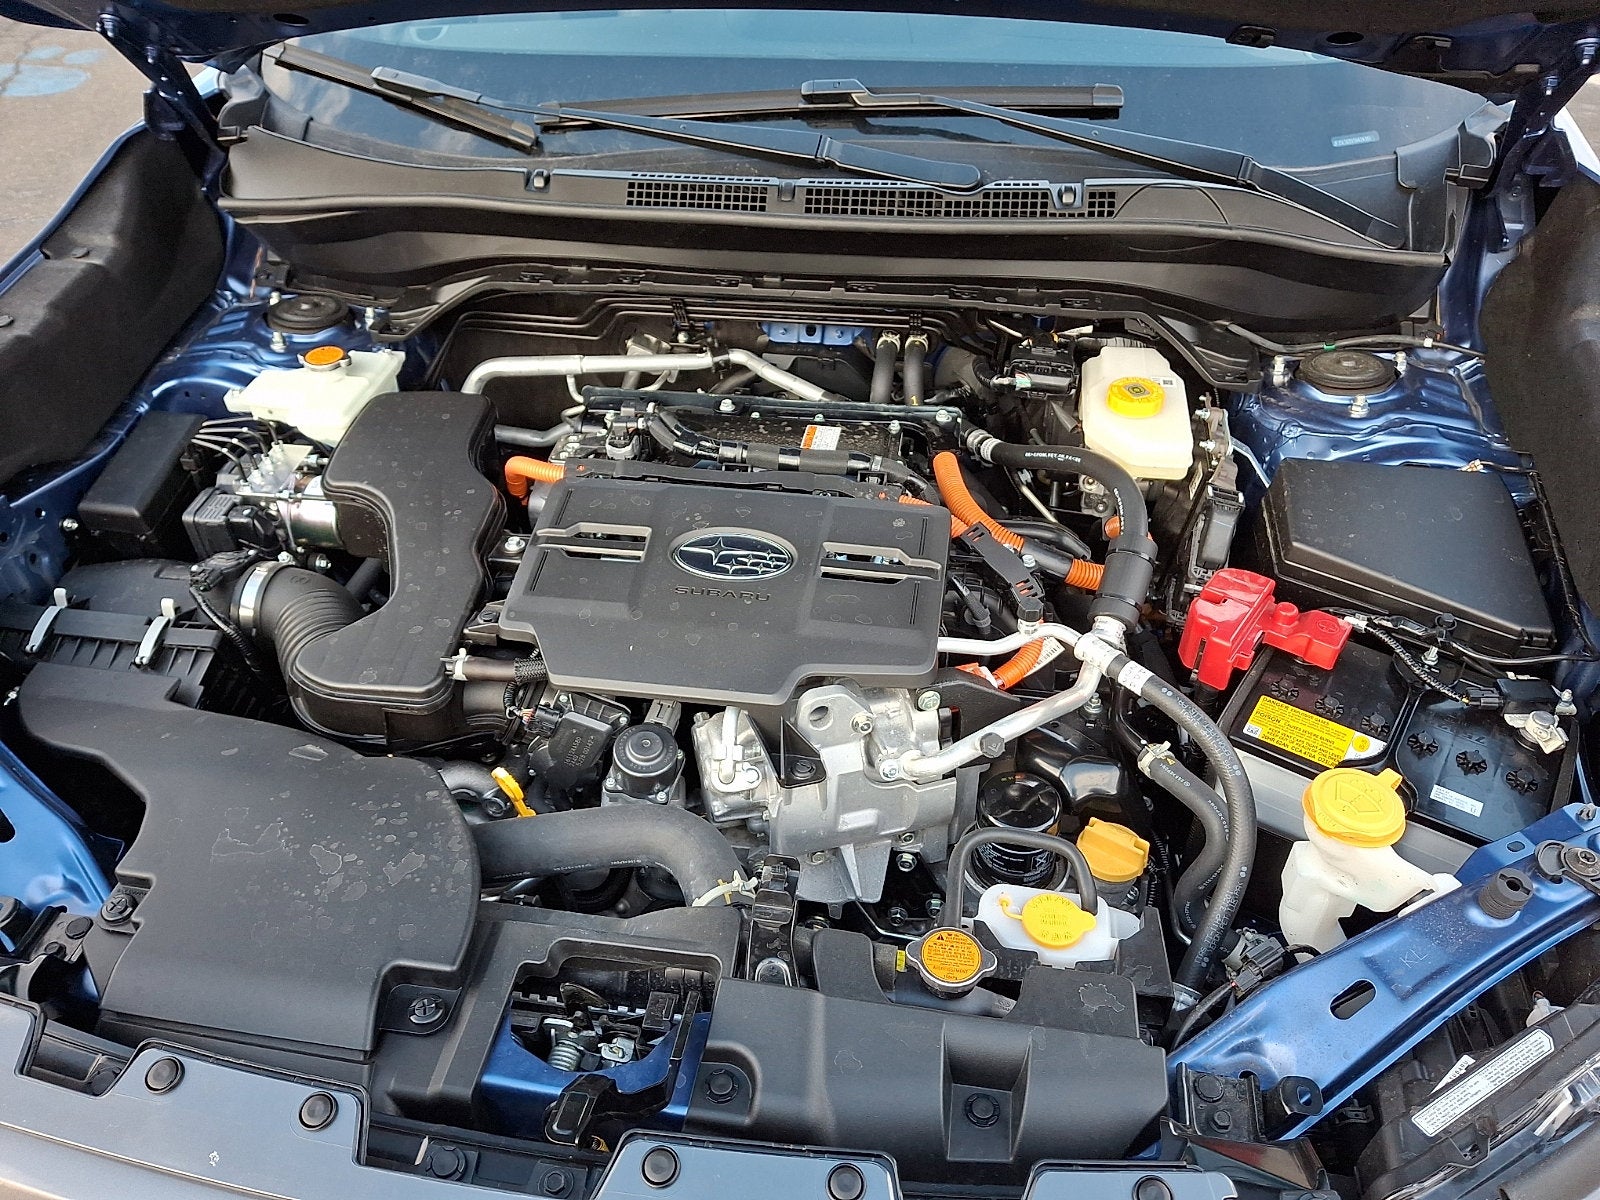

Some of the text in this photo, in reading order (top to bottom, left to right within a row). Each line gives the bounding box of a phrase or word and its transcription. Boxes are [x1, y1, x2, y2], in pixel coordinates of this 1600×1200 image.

[675, 585, 771, 602] SUBARU
[1261, 696, 1290, 710] DANGER
[1254, 710, 1281, 724] POISON
